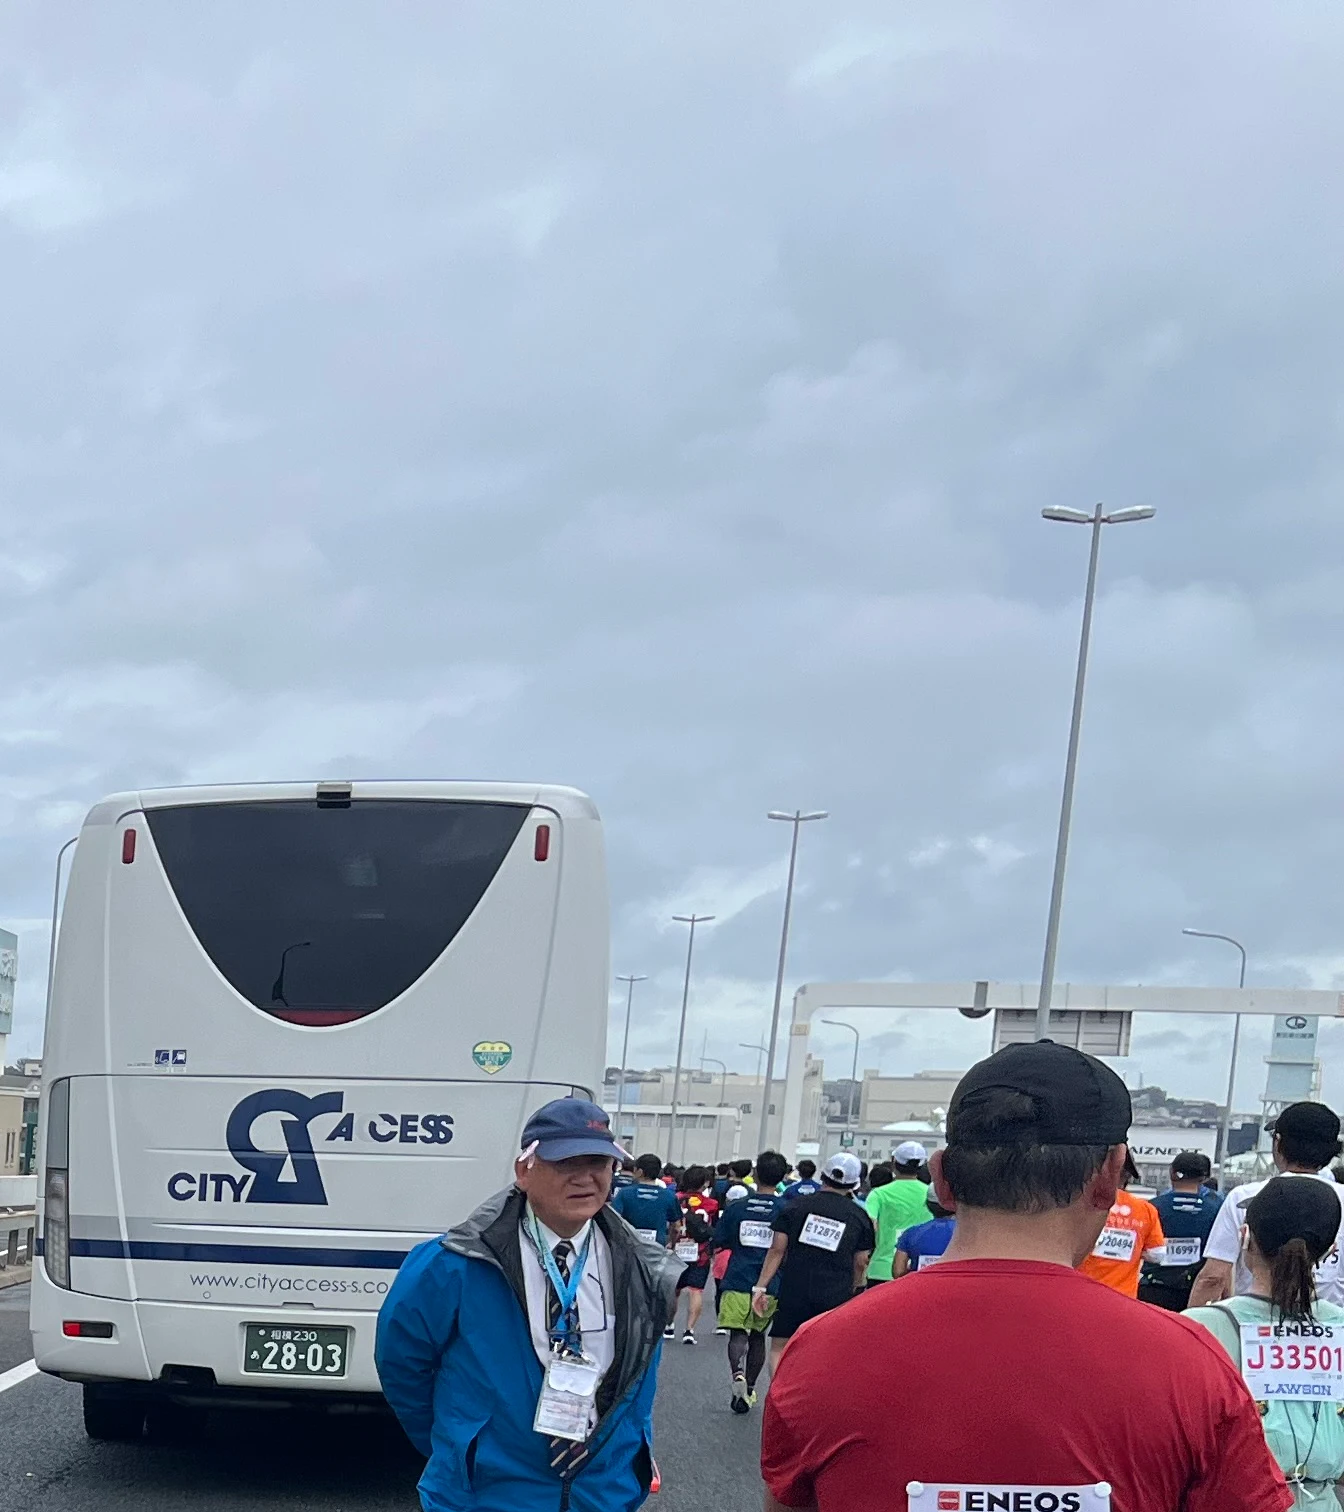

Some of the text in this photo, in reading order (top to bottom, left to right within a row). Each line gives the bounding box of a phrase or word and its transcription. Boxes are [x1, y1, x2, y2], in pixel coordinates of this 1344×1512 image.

[167, 1171, 251, 1202] CITY
[292, 1330, 318, 1342] 230
[1273, 1325, 1334, 1338] ENEOS
[261, 1341, 342, 1372] 28-03
[1247, 1344, 1342, 1373] J33501
[1263, 1383, 1332, 1396] LAWSON
